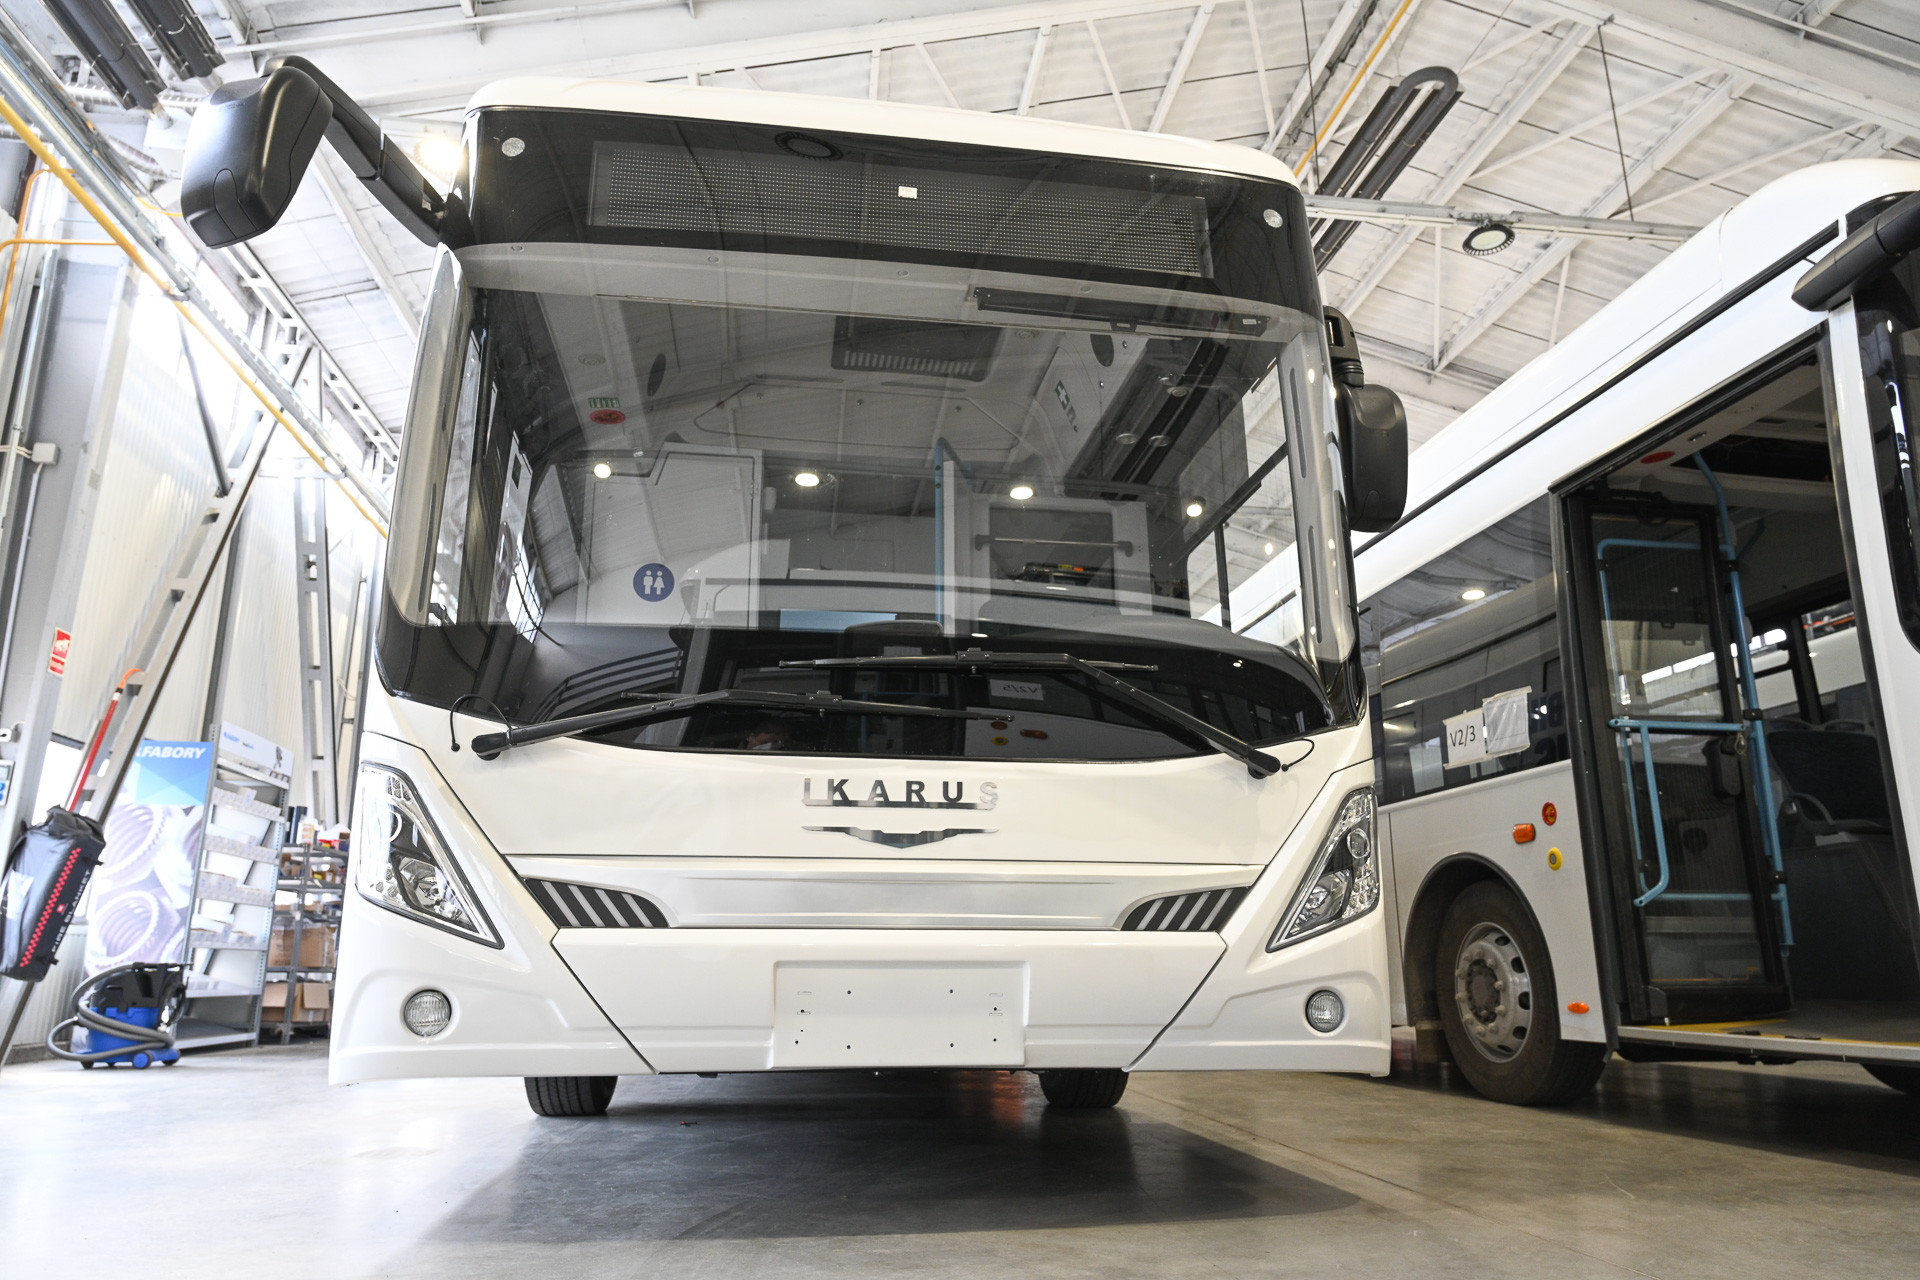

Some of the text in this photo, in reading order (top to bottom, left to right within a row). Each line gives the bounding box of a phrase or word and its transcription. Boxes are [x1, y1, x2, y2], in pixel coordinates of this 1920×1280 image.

[1449, 725, 1476, 747] V2/3
[141, 745, 207, 759] FABORY
[802, 777, 999, 810] IKARUS
[51, 925, 67, 953] FIRE
[64, 869, 91, 924] BLANKET
